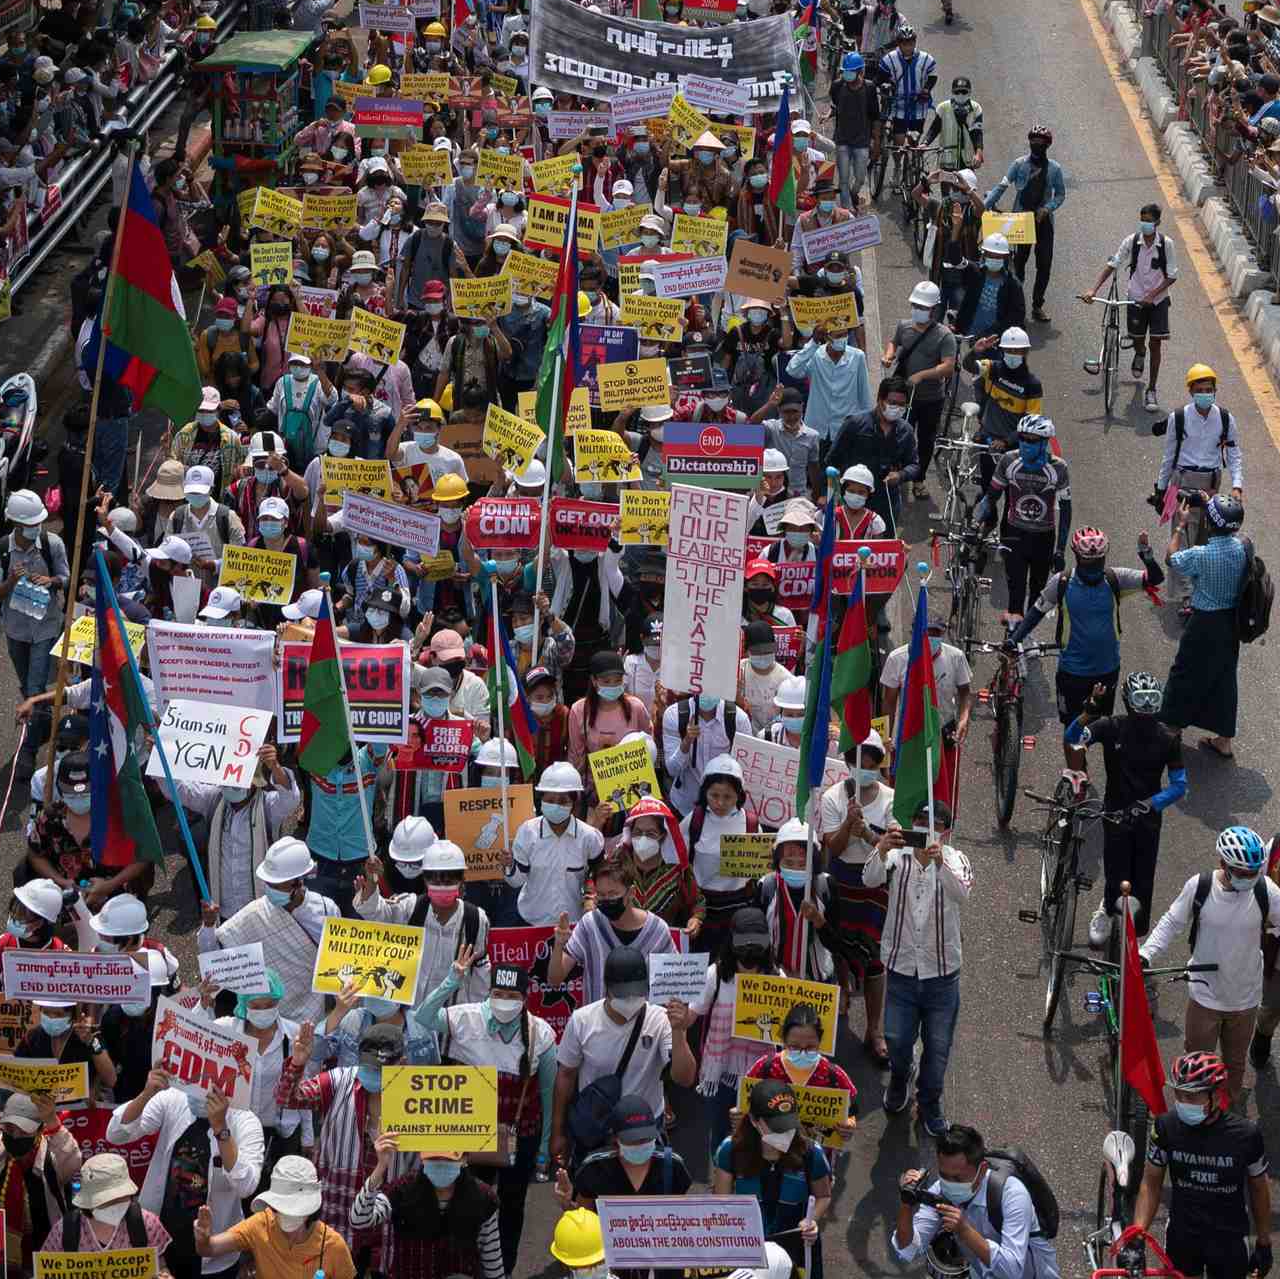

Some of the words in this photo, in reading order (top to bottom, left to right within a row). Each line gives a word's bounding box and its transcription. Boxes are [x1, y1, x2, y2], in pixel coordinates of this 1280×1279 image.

[539, 208, 554, 221] AM
[557, 211, 594, 229] BMA
[663, 284, 677, 293] END
[677, 278, 721, 292] DICTATORSHIP
[604, 379, 626, 388] STOP
[627, 374, 663, 385] BACKING
[604, 388, 640, 398] MILITARY
[642, 384, 665, 394] COUP
[702, 435, 723, 446] END
[613, 445, 627, 456] CO
[670, 458, 756, 474] Dictatorship
[514, 503, 530, 516] IN
[626, 496, 640, 506] We
[642, 496, 665, 507] Don't
[673, 487, 739, 520] FREE
[556, 510, 584, 525] GET
[587, 511, 619, 527] OUT
[627, 507, 670, 518] MILITARY
[556, 524, 612, 539] DICTATO
[680, 517, 727, 543] OUR
[227, 550, 240, 561] We
[242, 552, 265, 564] Don't
[266, 555, 292, 568] Accept
[670, 537, 743, 566] LEADERS
[871, 552, 899, 567] OUT
[227, 561, 263, 574] MILITARY
[264, 564, 290, 577] COUP
[676, 561, 736, 586] STOP
[686, 582, 724, 607] THE
[689, 607, 710, 696] RAIDS
[286, 654, 402, 692] RECT
[285, 709, 304, 726] TH
[369, 711, 402, 727] COUP
[433, 726, 463, 738] FREE
[437, 735, 464, 747] OUR
[174, 739, 226, 771] YGN
[423, 743, 471, 755] LEADER
[608, 751, 627, 769] Don't
[626, 744, 647, 765] Accept
[596, 763, 628, 781] MILITARY
[628, 757, 649, 774] COUP
[736, 748, 849, 785] RELESE
[328, 924, 347, 937] We
[350, 926, 381, 943] Don't
[382, 930, 419, 948] Accept
[328, 940, 381, 957] MILITARY
[382, 946, 415, 961] COUP
[492, 941, 529, 962] Heal
[20, 982, 44, 993] END
[47, 983, 132, 995] DICTATORSHIP
[741, 979, 760, 993] We
[761, 981, 794, 999] Don't
[795, 987, 834, 1005] Accept
[741, 992, 796, 1009] MILITARY
[799, 1000, 832, 1018] COUP
[161, 1039, 238, 1098] CDM
[410, 1074, 468, 1092] STOP
[404, 1097, 473, 1115] CRIME
[810, 1092, 844, 1108] Accept
[808, 1103, 841, 1117] COUP
[386, 1123, 432, 1134] AGAINST
[434, 1123, 491, 1134] HUMANITY
[1172, 1150, 1233, 1168] MYANMAR
[1190, 1170, 1219, 1183] FIXIE
[613, 1238, 651, 1249] ABOLISH
[652, 1237, 670, 1248] THE
[671, 1237, 695, 1248] 2008
[696, 1236, 761, 1248] CONSTITUTION
[41, 1258, 63, 1271] We
[66, 1256, 103, 1270] Don't
[106, 1253, 151, 1269] Accept
[111, 1266, 150, 1279] COUP
